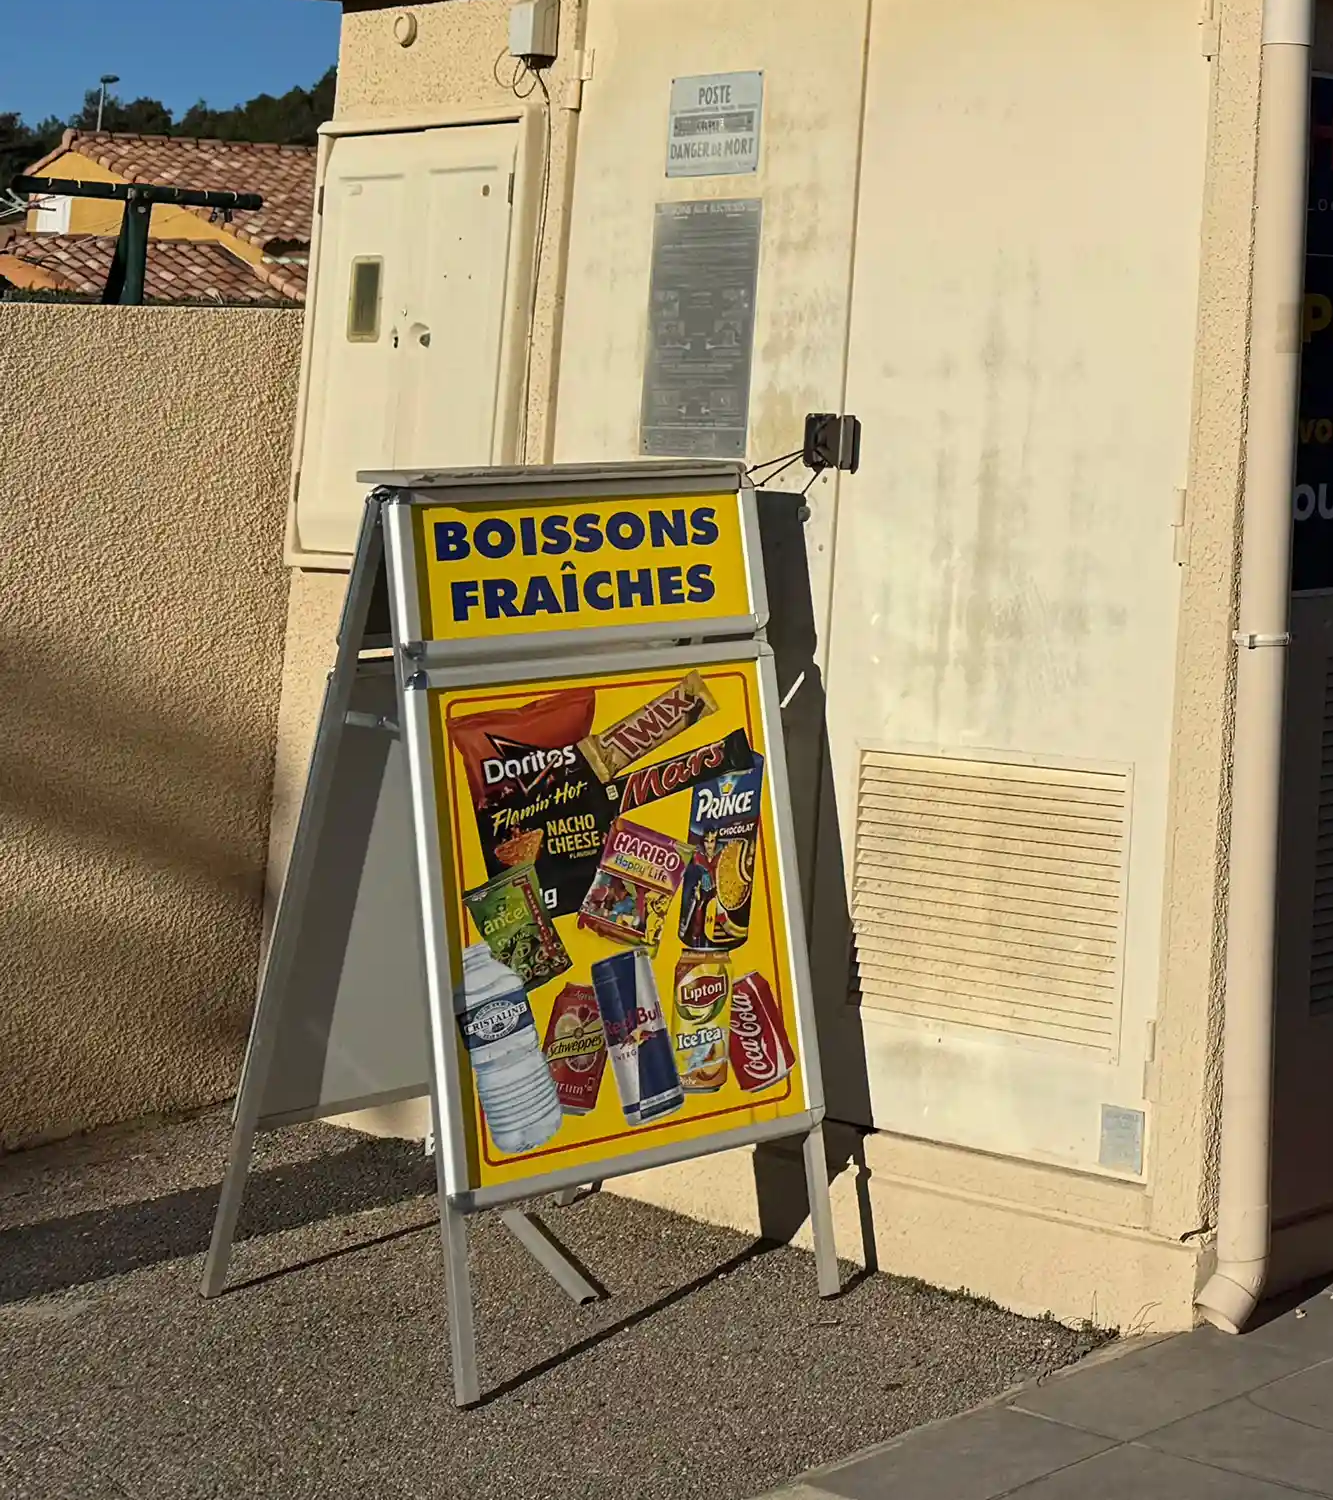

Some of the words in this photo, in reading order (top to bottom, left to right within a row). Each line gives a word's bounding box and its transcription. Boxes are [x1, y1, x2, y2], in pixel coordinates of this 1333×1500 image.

[699, 85, 731, 105] POSTE
[670, 141, 710, 160] DANGER
[724, 137, 754, 156] MORT
[433, 507, 720, 562] BOISSONS
[450, 560, 716, 622] FRAÎCHES
[482, 745, 577, 785] Doritos
[620, 740, 726, 814] Mars
[553, 780, 586, 805] Hot
[695, 788, 755, 823] PRINCE
[546, 813, 596, 837] NACHO
[719, 822, 755, 837] CHOCOLAT
[547, 831, 601, 855] CHEESE
[613, 832, 680, 872] HARIBO
[684, 981, 722, 1001] Lipton
[465, 1001, 527, 1035] CRISTALINE
[605, 1007, 636, 1037] Red
[677, 1033, 699, 1049] Ice
[698, 1027, 722, 1045] Tea
[730, 989, 777, 1081] Coca-Cola
